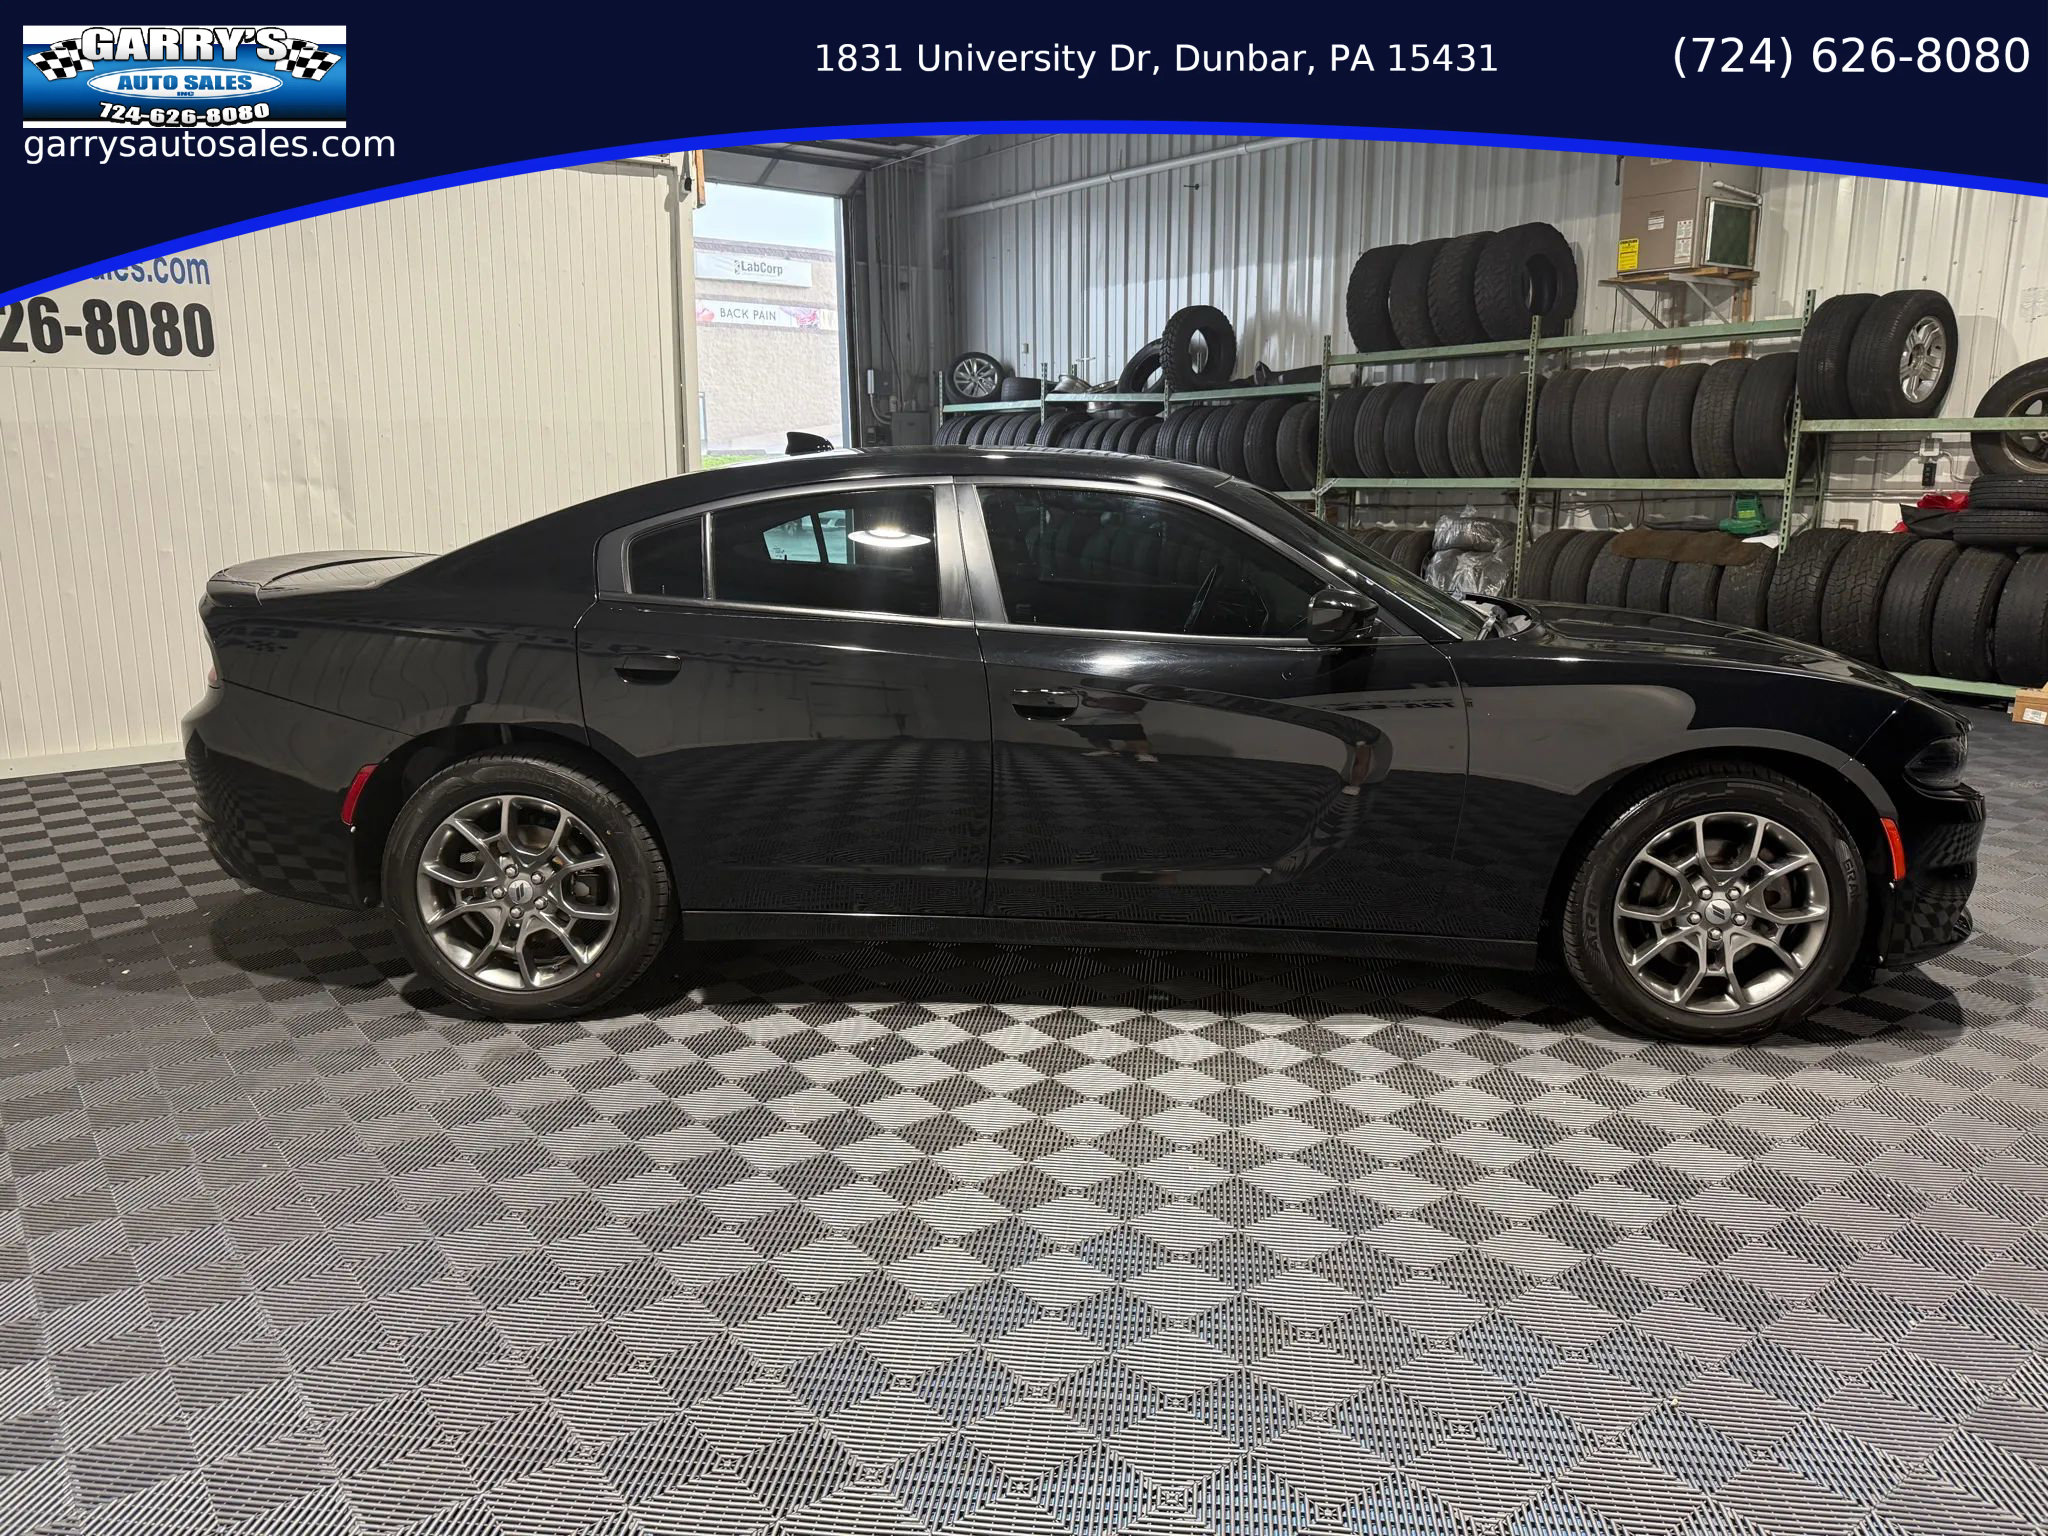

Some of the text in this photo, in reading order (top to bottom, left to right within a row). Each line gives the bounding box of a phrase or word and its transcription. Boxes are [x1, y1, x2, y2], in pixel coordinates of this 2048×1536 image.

[741, 260, 783, 276] LabCorp
[720, 307, 776, 321] BACK PAIN
